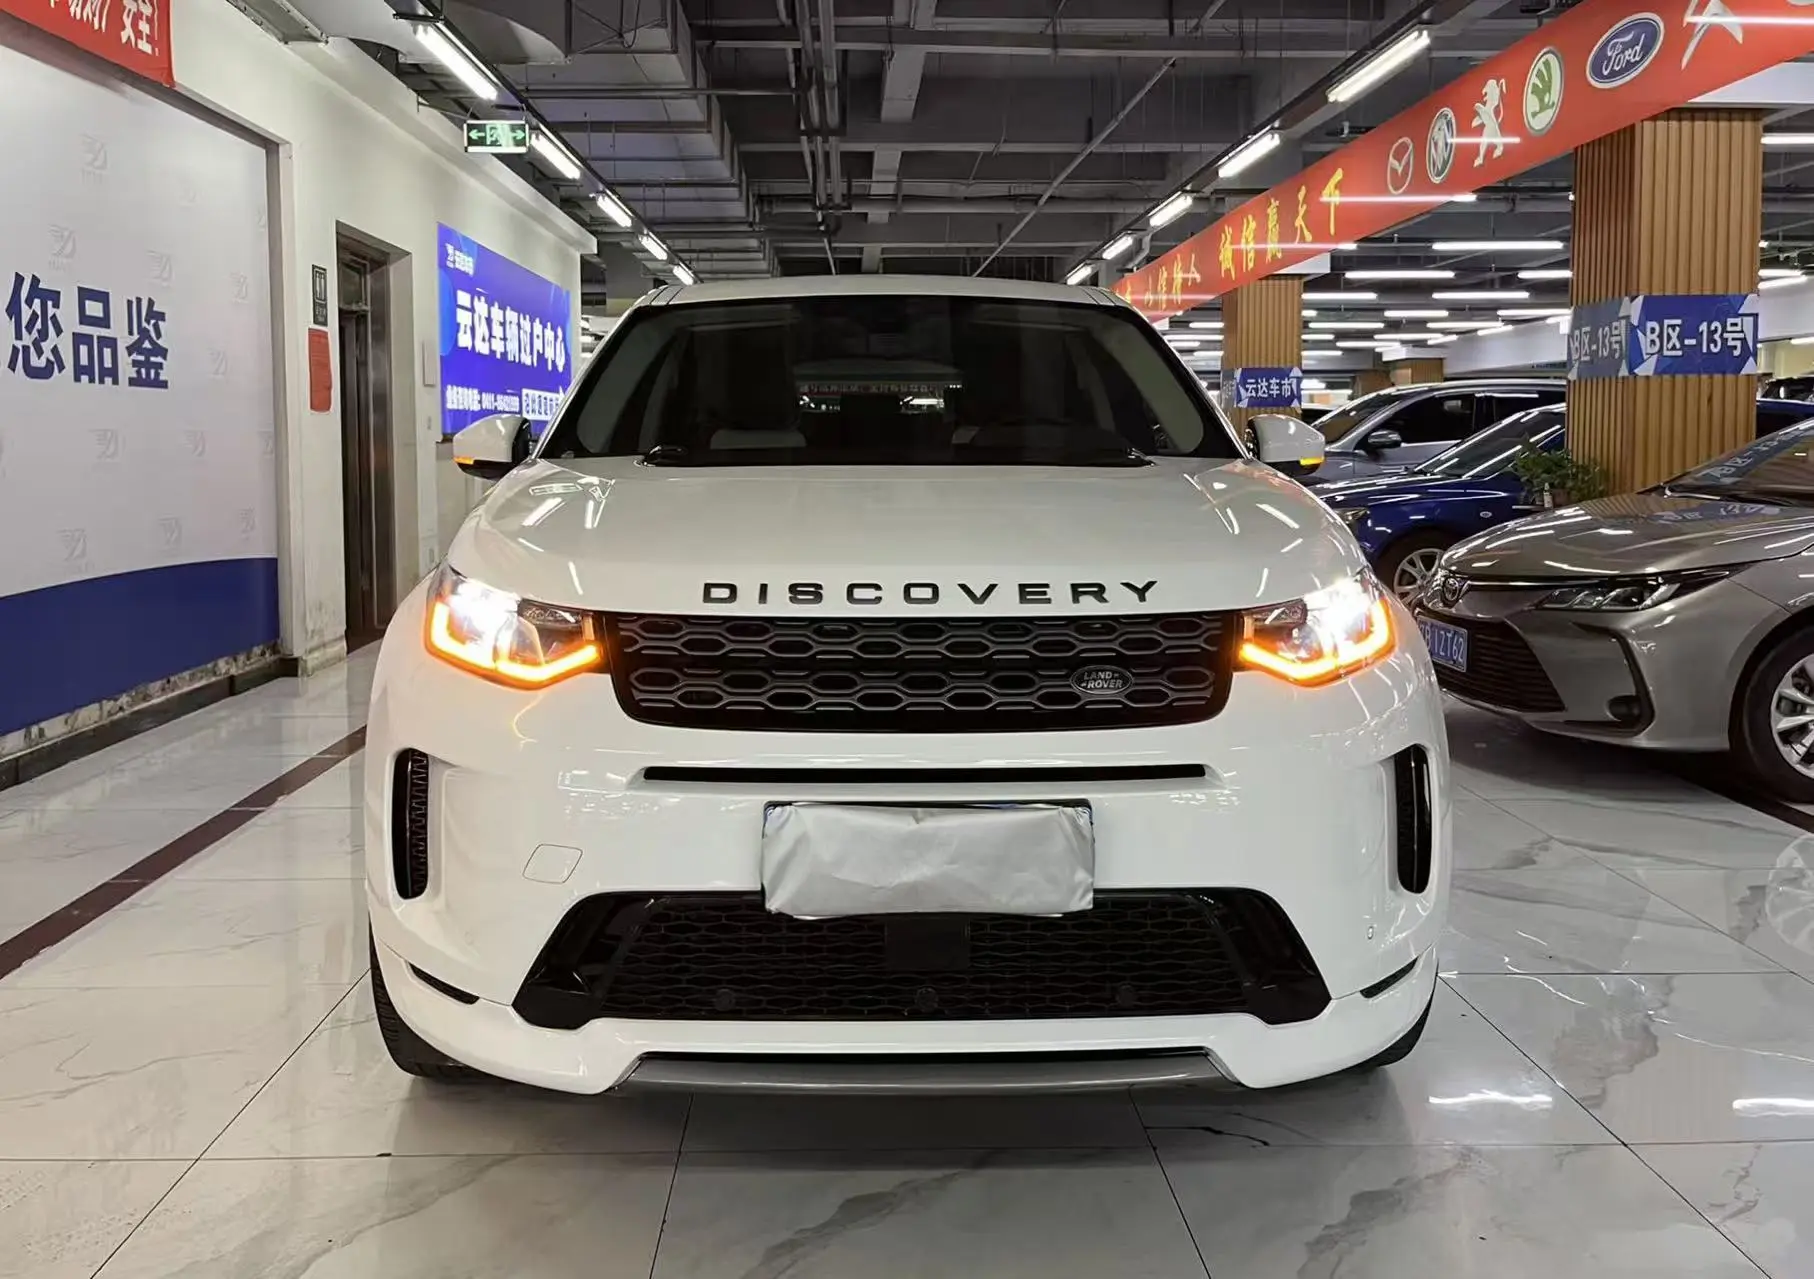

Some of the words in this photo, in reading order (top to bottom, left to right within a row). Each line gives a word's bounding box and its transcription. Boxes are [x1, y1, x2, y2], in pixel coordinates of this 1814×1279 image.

[1602, 31, 1646, 76] Ford
[5, 271, 169, 389] 您品鉴
[456, 289, 566, 373] 云达车辆过户中心
[1645, 316, 1745, 357] B区-13号
[1245, 376, 1292, 398] 云达车市
[702, 580, 1159, 605] DISCOVERY
